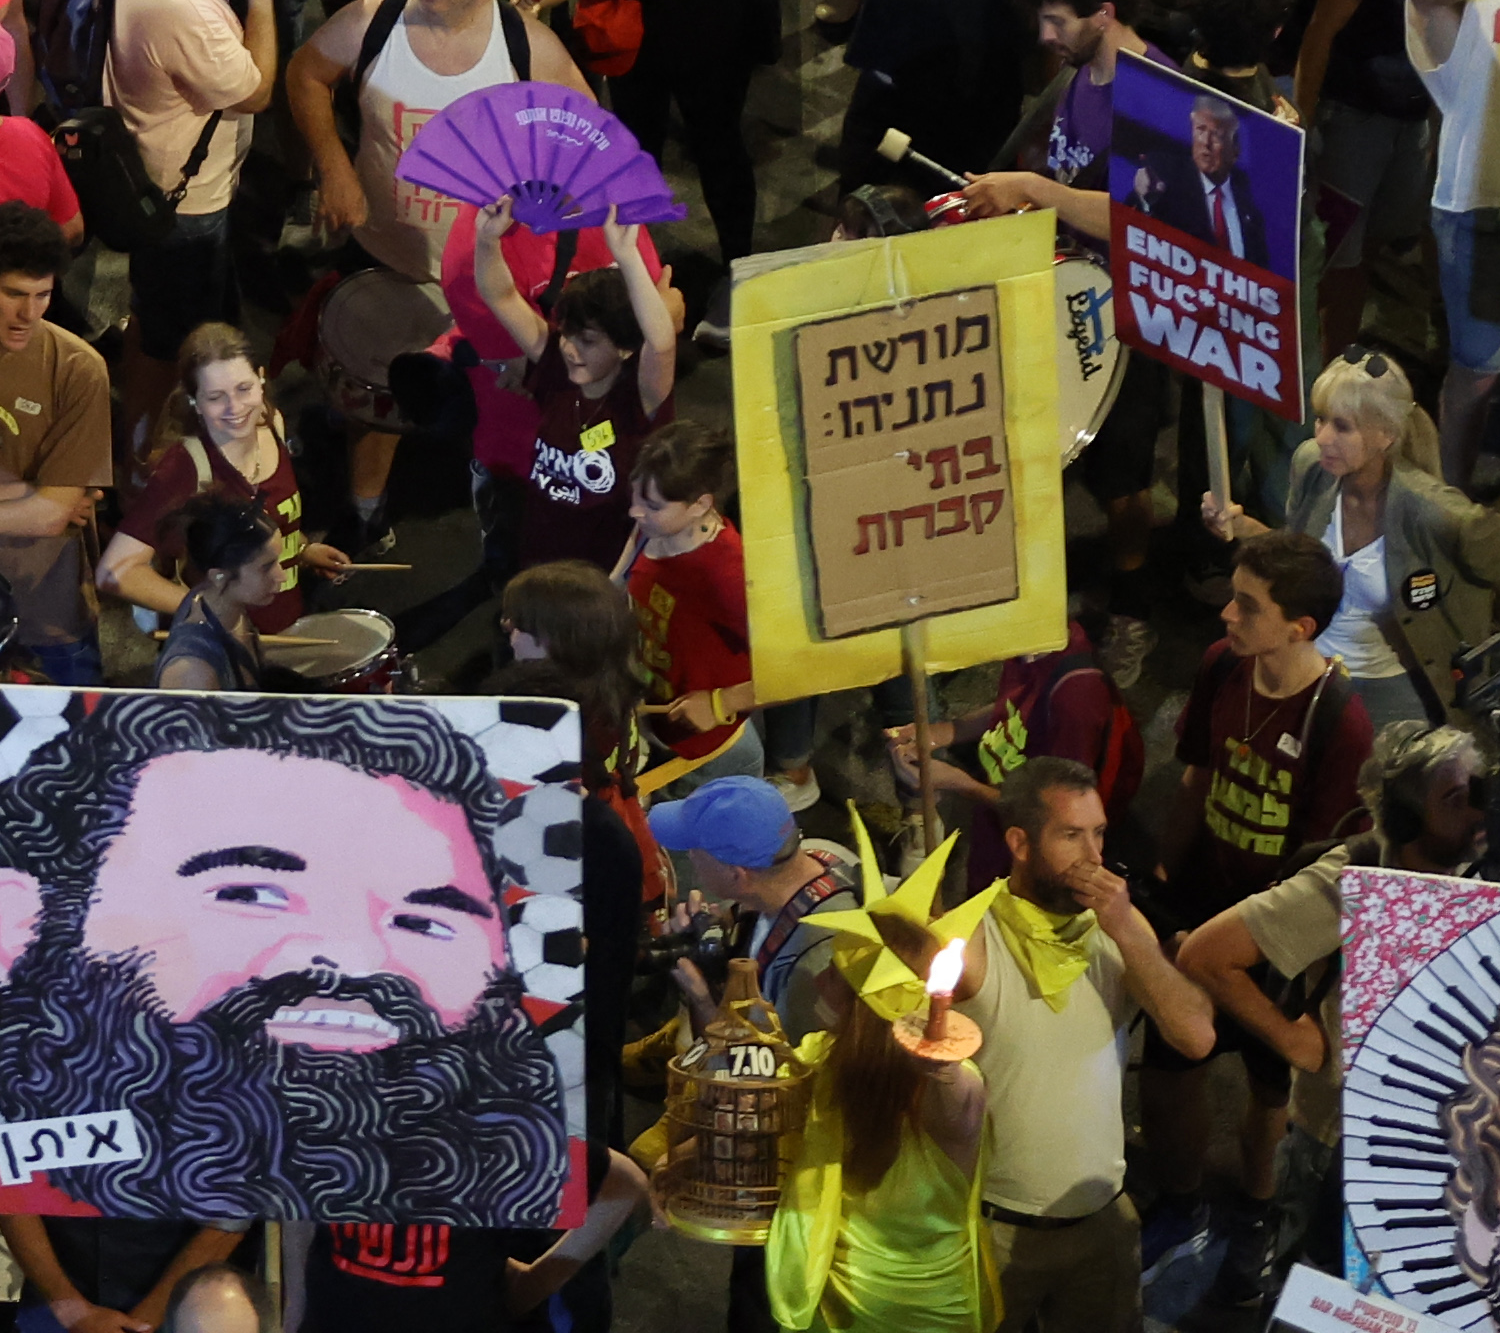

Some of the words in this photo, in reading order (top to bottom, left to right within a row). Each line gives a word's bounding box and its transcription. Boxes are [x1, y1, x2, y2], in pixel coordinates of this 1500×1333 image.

[1125, 225, 1199, 277] END
[1200, 250, 1282, 317] THIS
[823, 313, 990, 387] מורשת
[1065, 290, 1103, 383] Legend
[1126, 290, 1283, 402] WAR
[904, 433, 1000, 491] בתי
[852, 490, 1003, 556] קברות
[729, 1045, 775, 1077] 7.10
[2, 1114, 120, 1178] איתן
